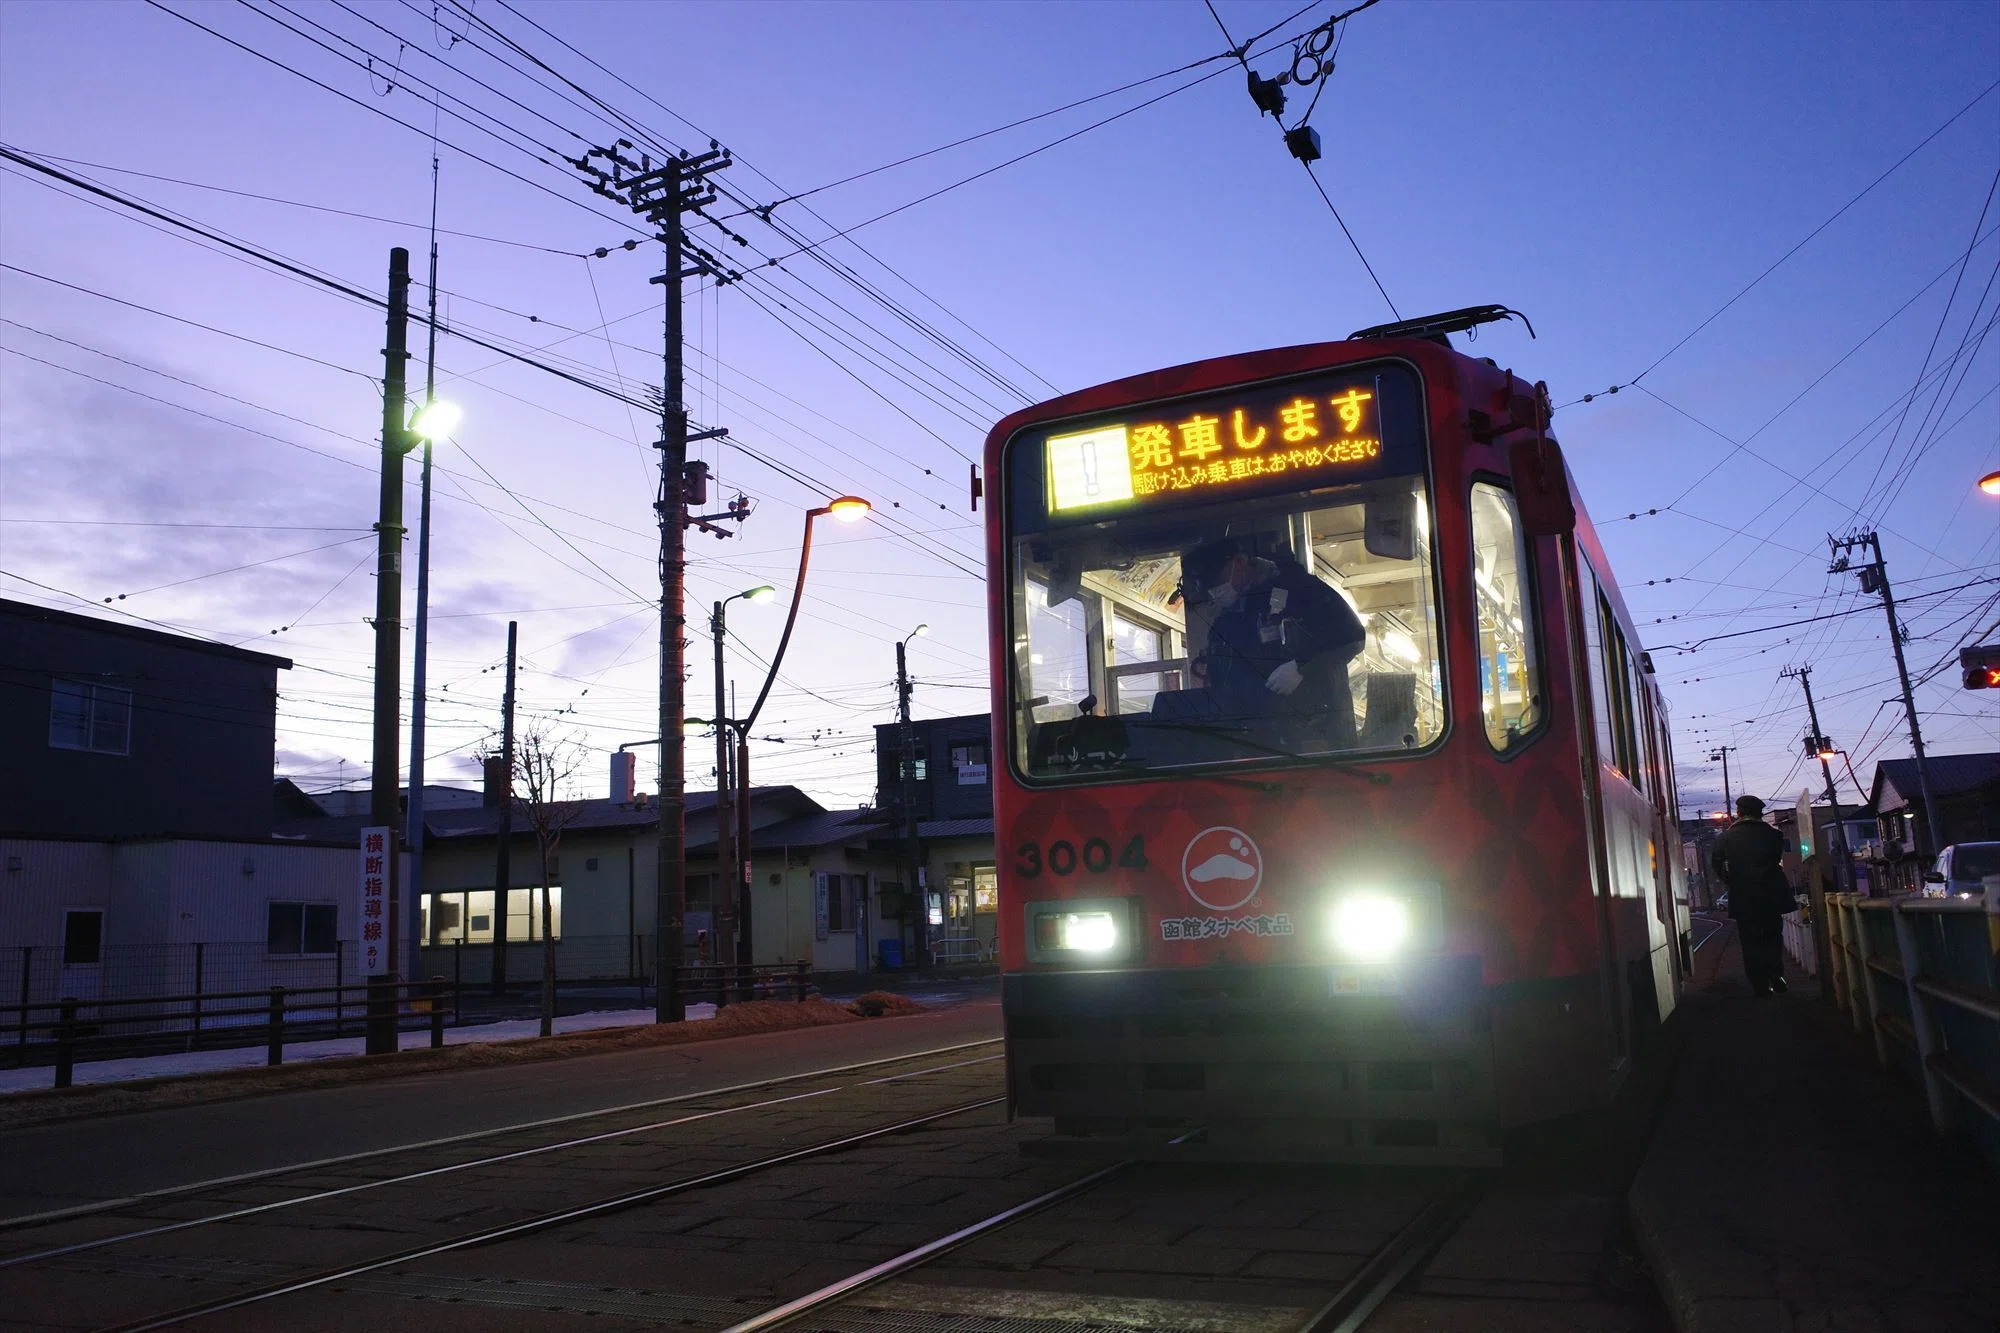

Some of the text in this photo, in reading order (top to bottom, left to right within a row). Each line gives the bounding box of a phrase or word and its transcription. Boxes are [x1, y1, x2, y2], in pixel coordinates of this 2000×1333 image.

[1131, 389, 1372, 470] 発車します
[1132, 440, 1380, 495] 駆け込み乗車は、おやめください
[1015, 833, 1148, 879] 3004
[1161, 913, 1294, 940] 函館タナベ食品
